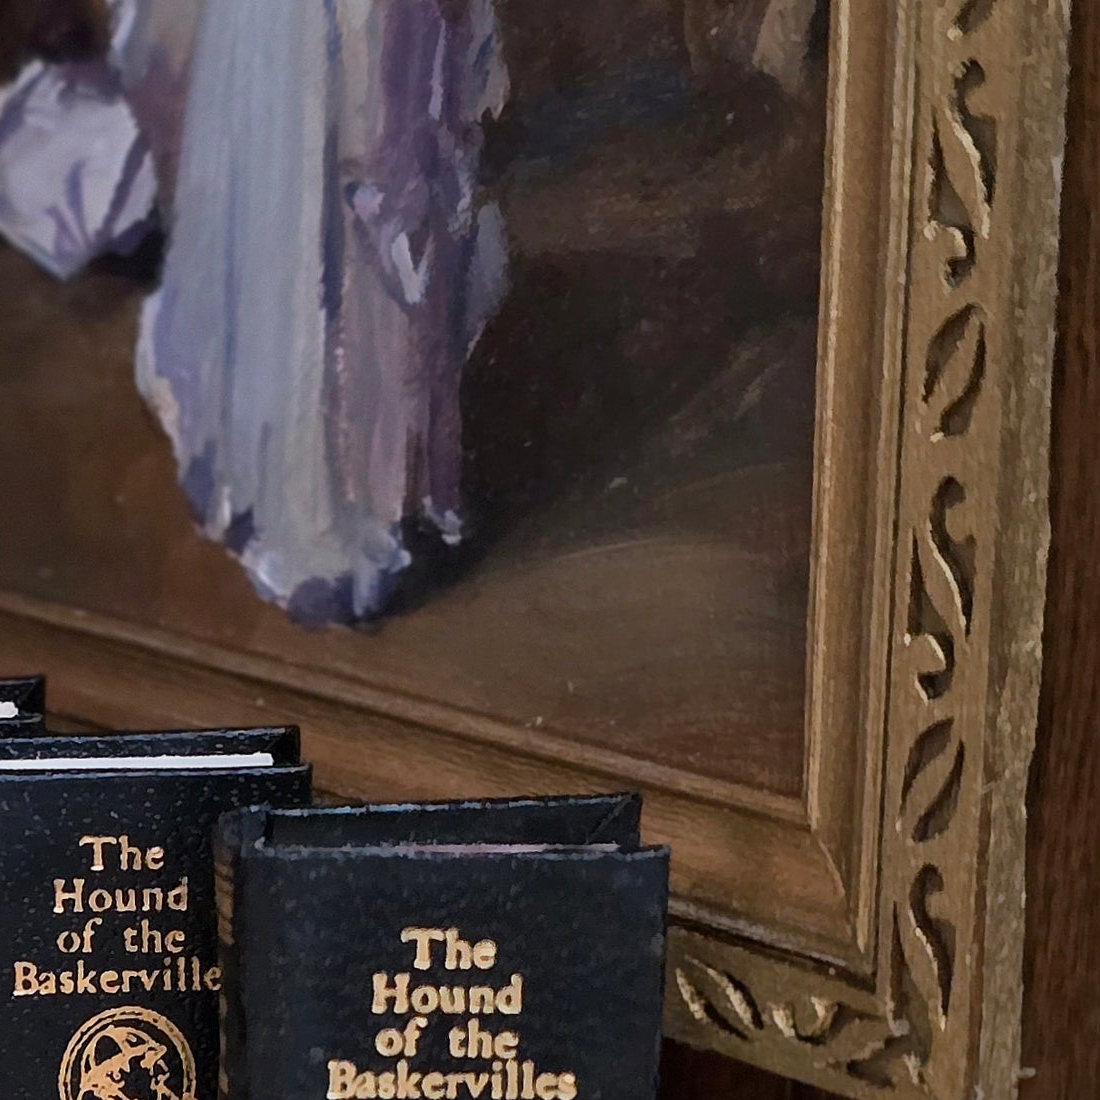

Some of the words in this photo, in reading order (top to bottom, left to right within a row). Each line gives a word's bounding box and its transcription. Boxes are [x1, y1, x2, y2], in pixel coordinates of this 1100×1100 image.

[78, 834, 166, 872] The
[52, 876, 189, 914] Hound
[55, 917, 104, 954] of
[123, 918, 186, 954] the
[400, 926, 498, 971] The
[12, 956, 223, 997] Baskerville
[370, 971, 524, 1015] Hound
[374, 1016, 430, 1058] of
[448, 1017, 521, 1060] the
